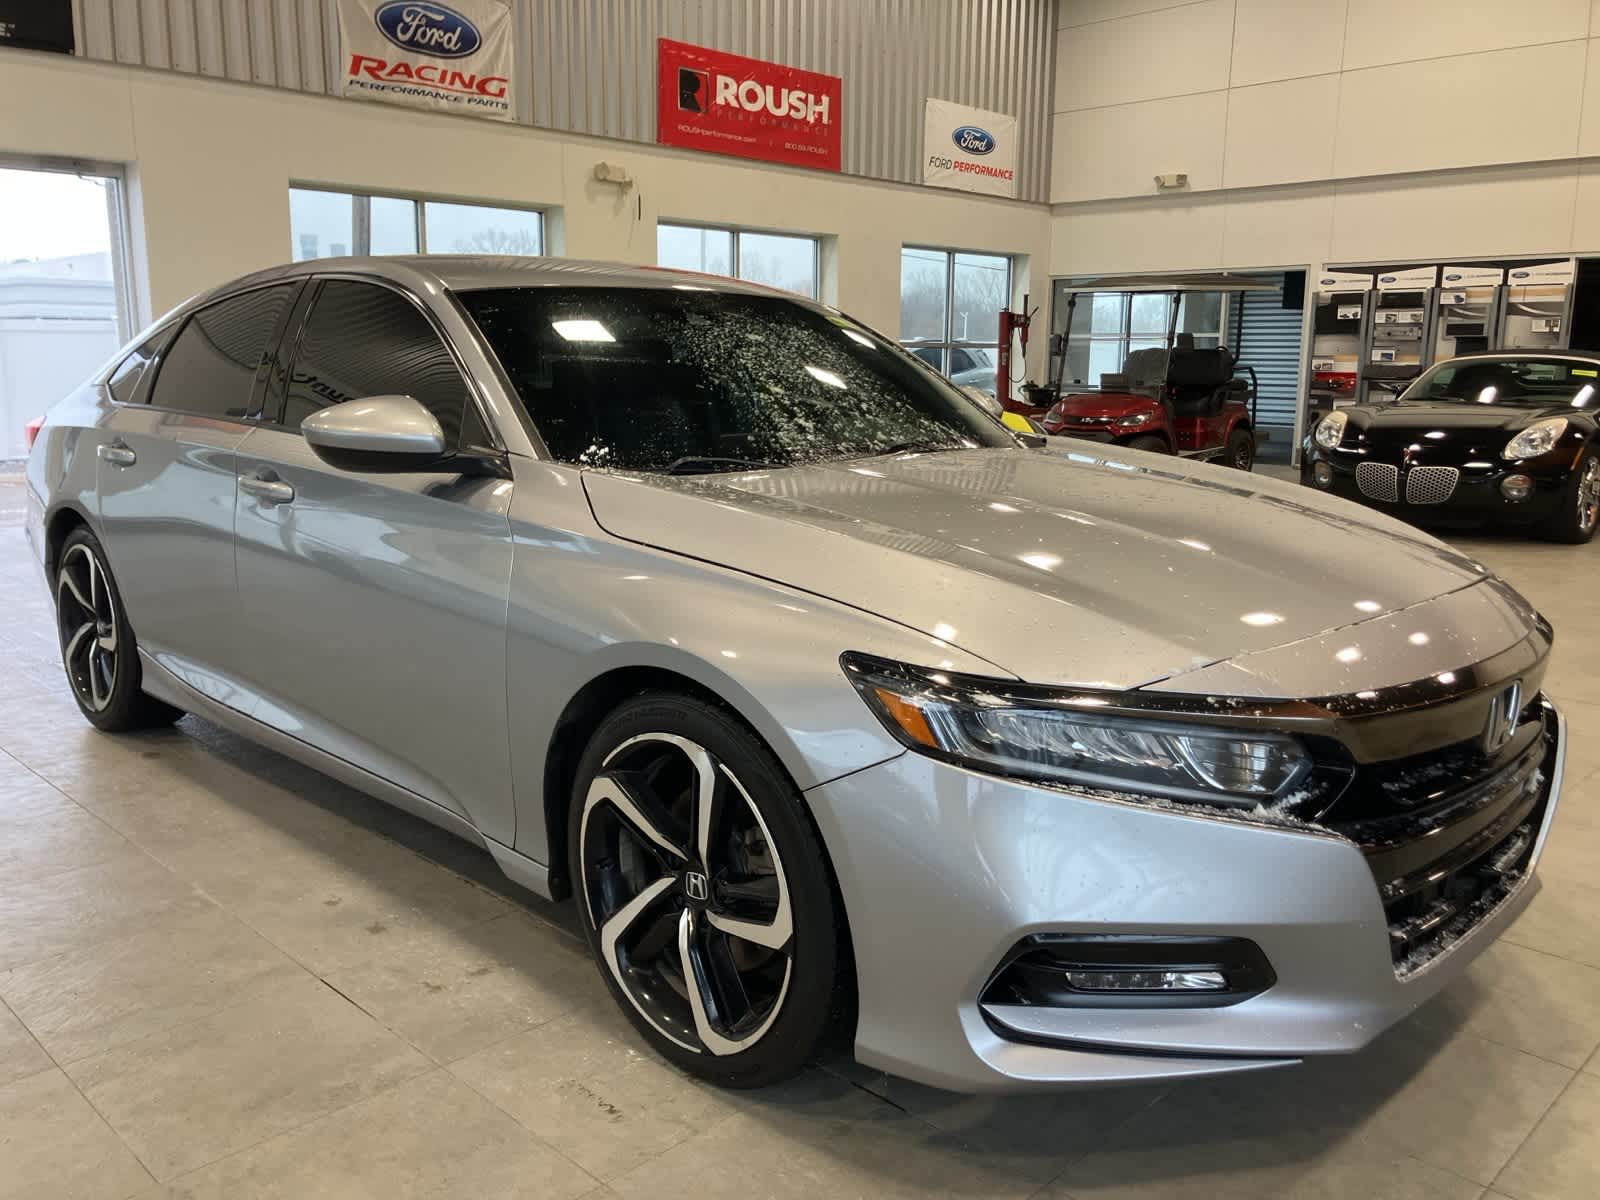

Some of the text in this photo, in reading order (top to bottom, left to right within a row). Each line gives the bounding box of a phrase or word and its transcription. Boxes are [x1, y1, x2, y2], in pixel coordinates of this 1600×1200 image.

[396, 6, 462, 51] Ford
[348, 79, 509, 110] PERFORMANCE PARTS
[349, 54, 509, 98] RACING
[715, 74, 830, 125] ROUSH
[960, 129, 988, 151] Ford
[928, 155, 1014, 181] FORD PERFORMANCE
